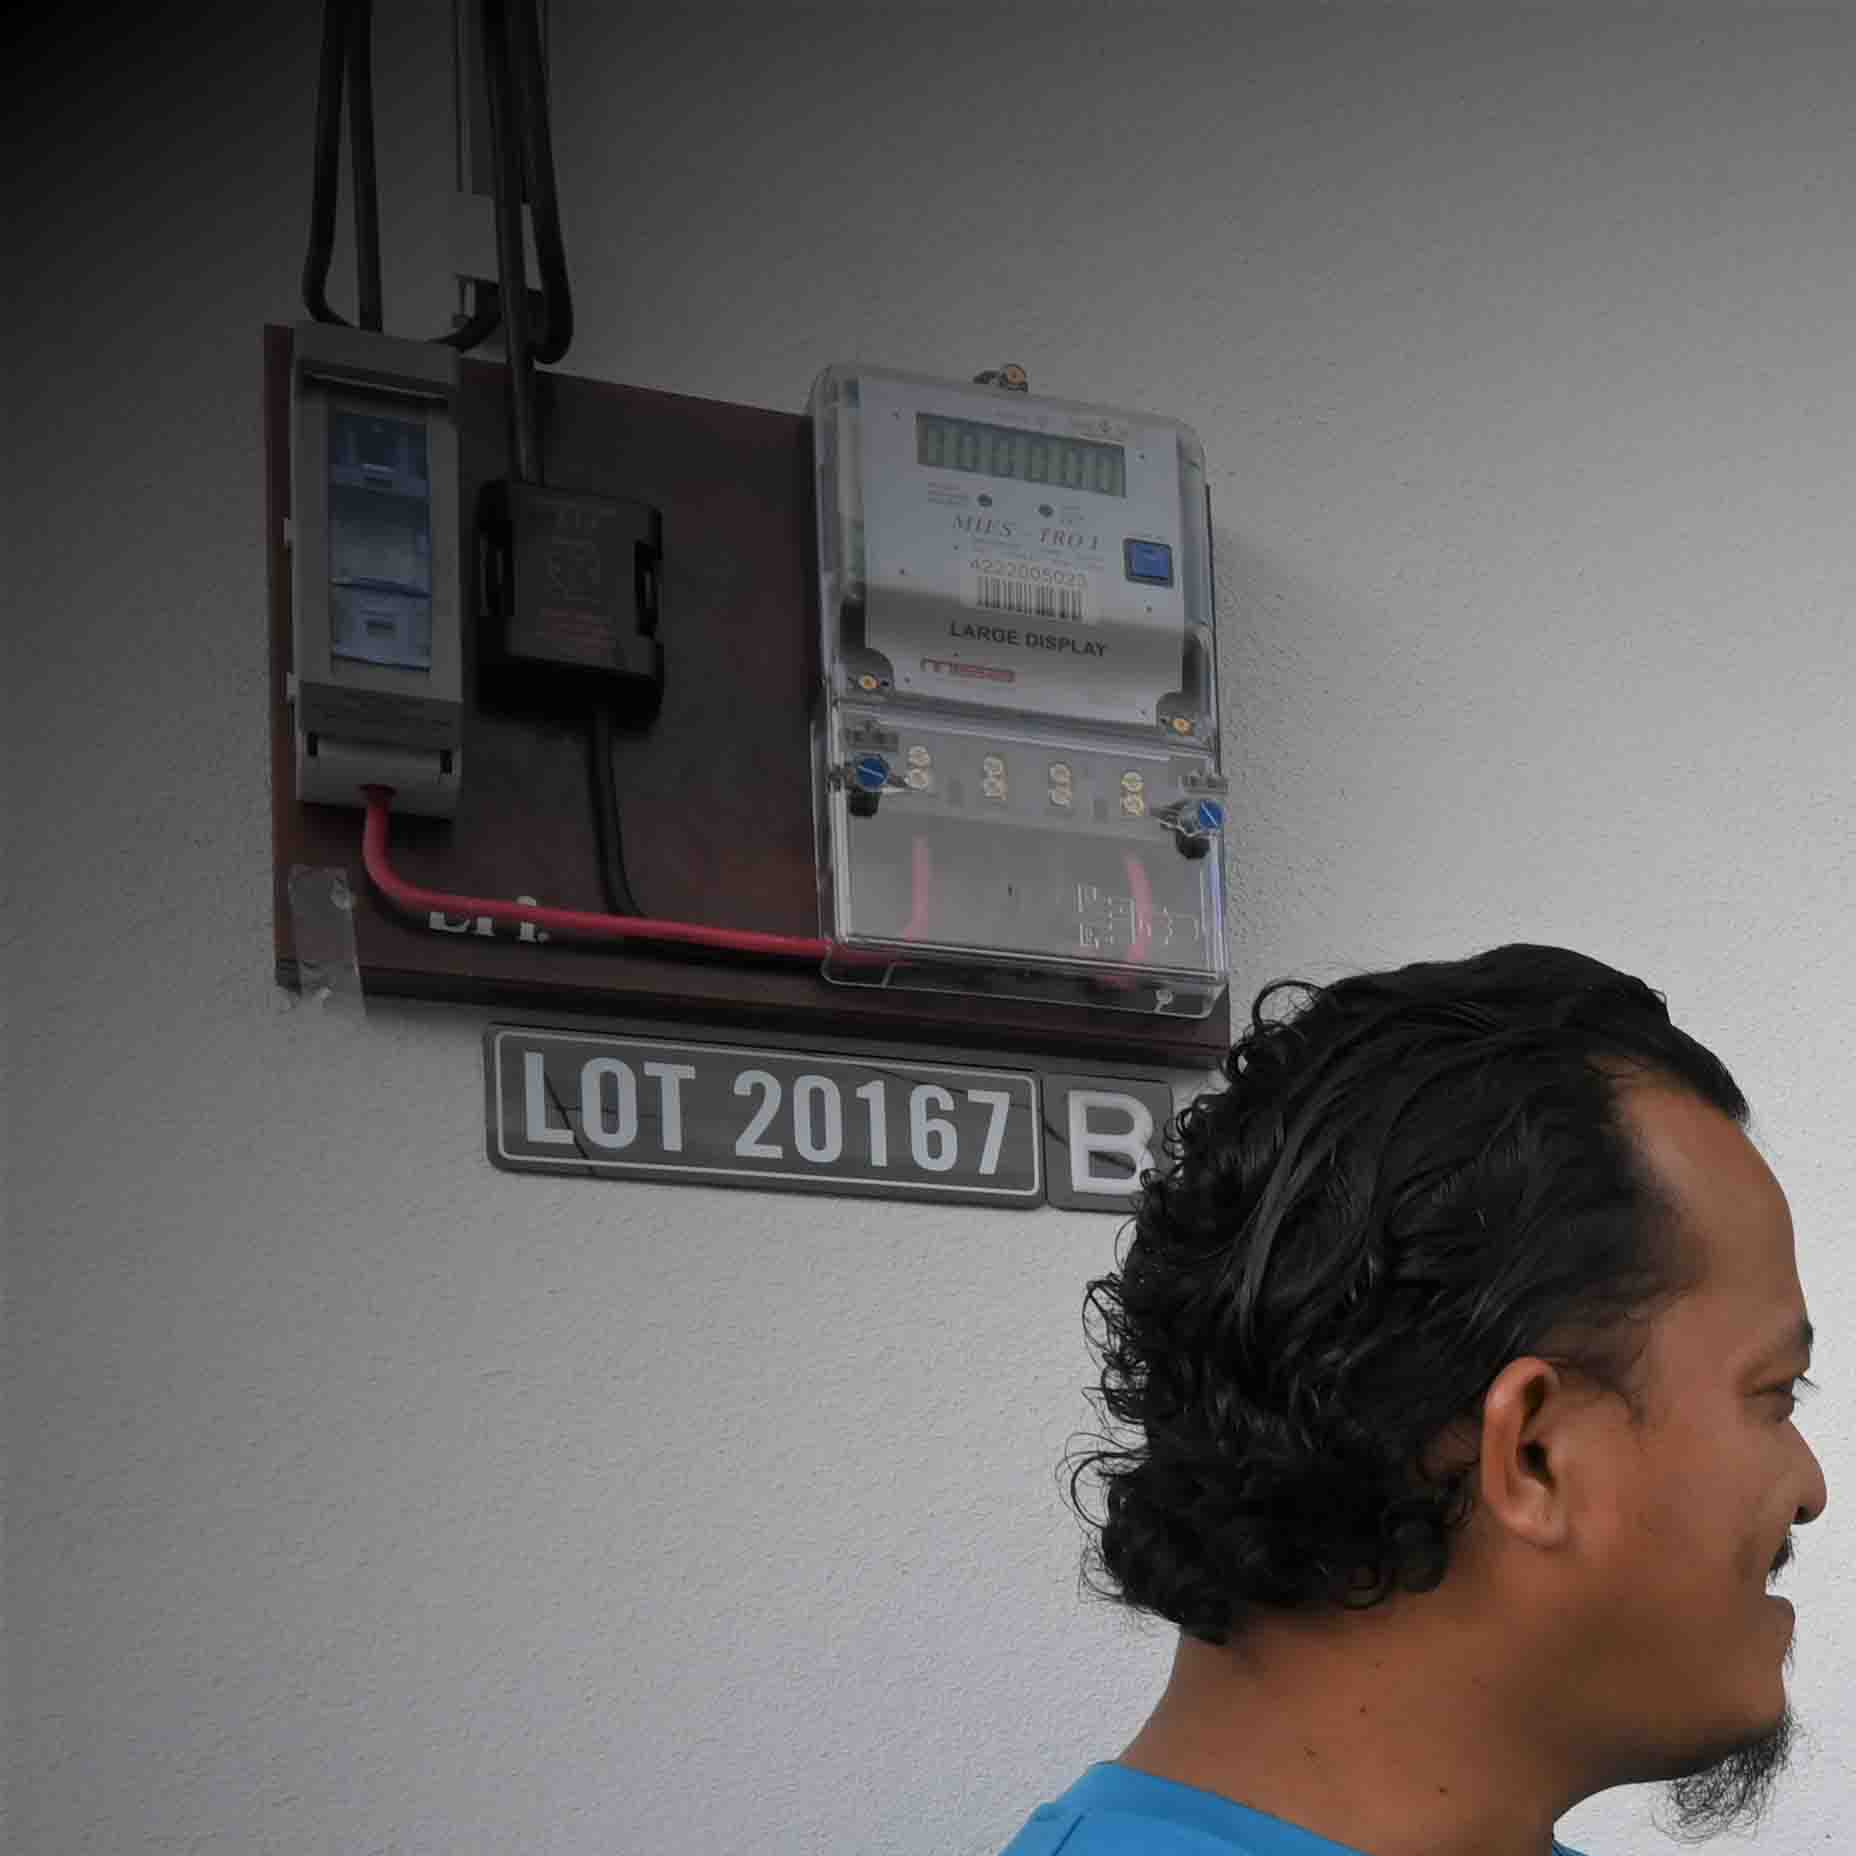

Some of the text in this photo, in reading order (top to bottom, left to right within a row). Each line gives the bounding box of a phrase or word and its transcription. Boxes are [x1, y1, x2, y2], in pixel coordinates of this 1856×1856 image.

[950, 621, 1107, 657] LARGE DISPLAY
[523, 1051, 1155, 1195] LOT 20167 B
